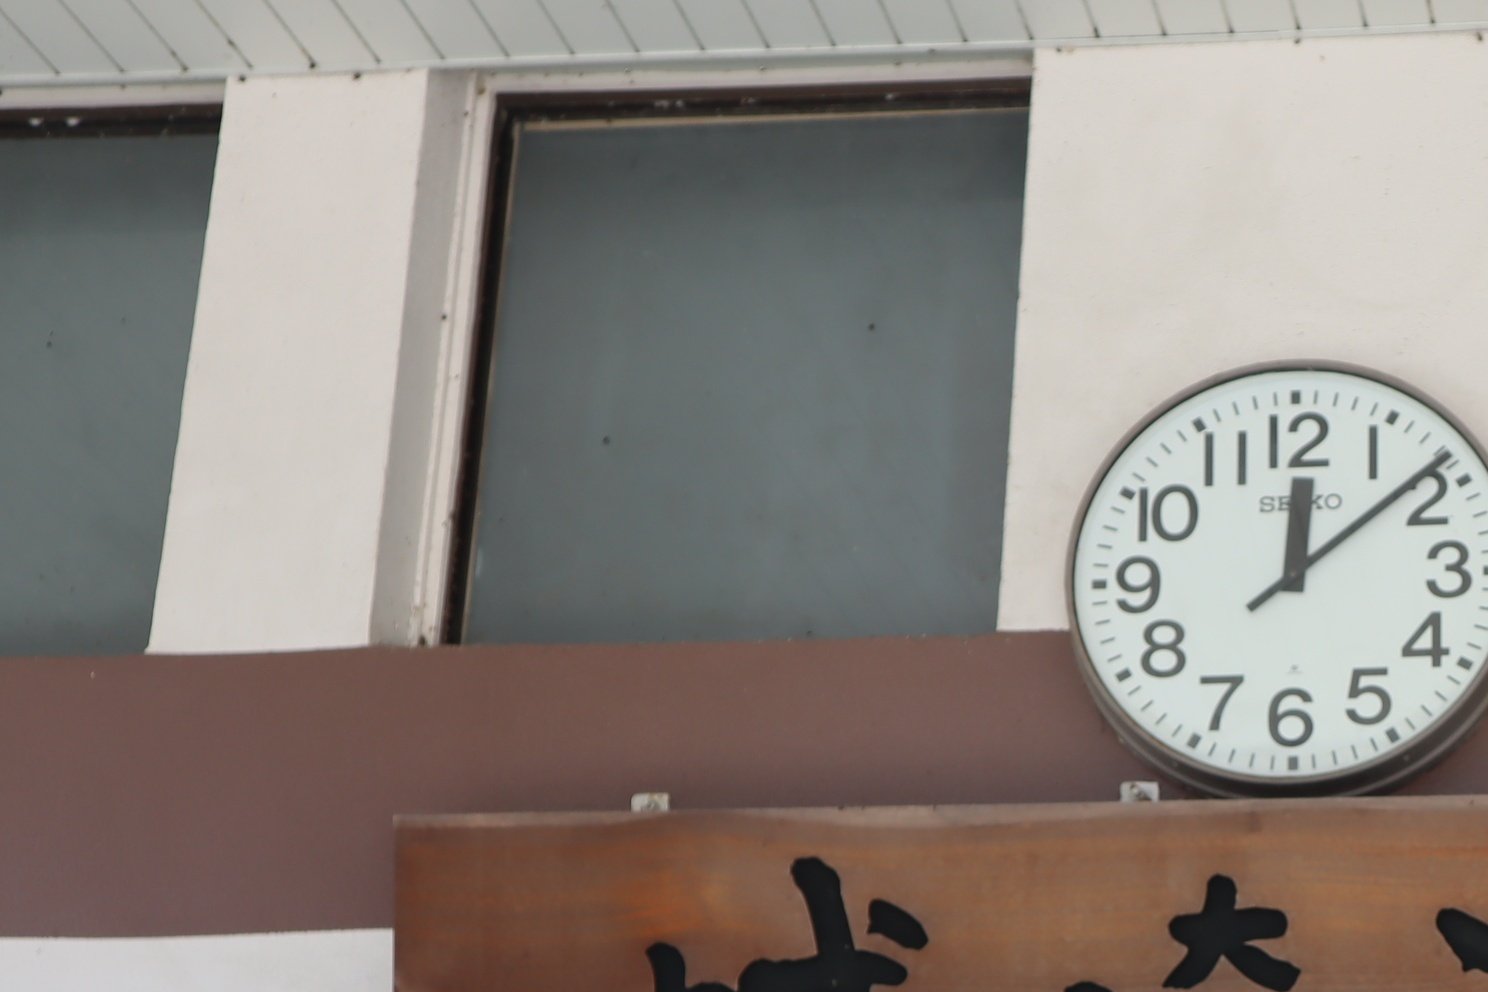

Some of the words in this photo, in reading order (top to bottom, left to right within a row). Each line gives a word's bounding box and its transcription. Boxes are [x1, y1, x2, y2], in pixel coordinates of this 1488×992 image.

[1204, 430, 1247, 487] 11
[1269, 411, 1330, 469] 12
[1368, 425, 1378, 480] 1
[1138, 484, 1199, 542] 10
[1259, 493, 1342, 513] SEKO
[1406, 467, 1450, 527] 2
[1115, 556, 1162, 614] 9
[1425, 540, 1473, 599] 3
[1140, 619, 1186, 678] 8
[1401, 611, 1450, 668] 4
[1200, 674, 1245, 732] 7
[1267, 688, 1315, 747] 6
[1345, 667, 1392, 725] 5
